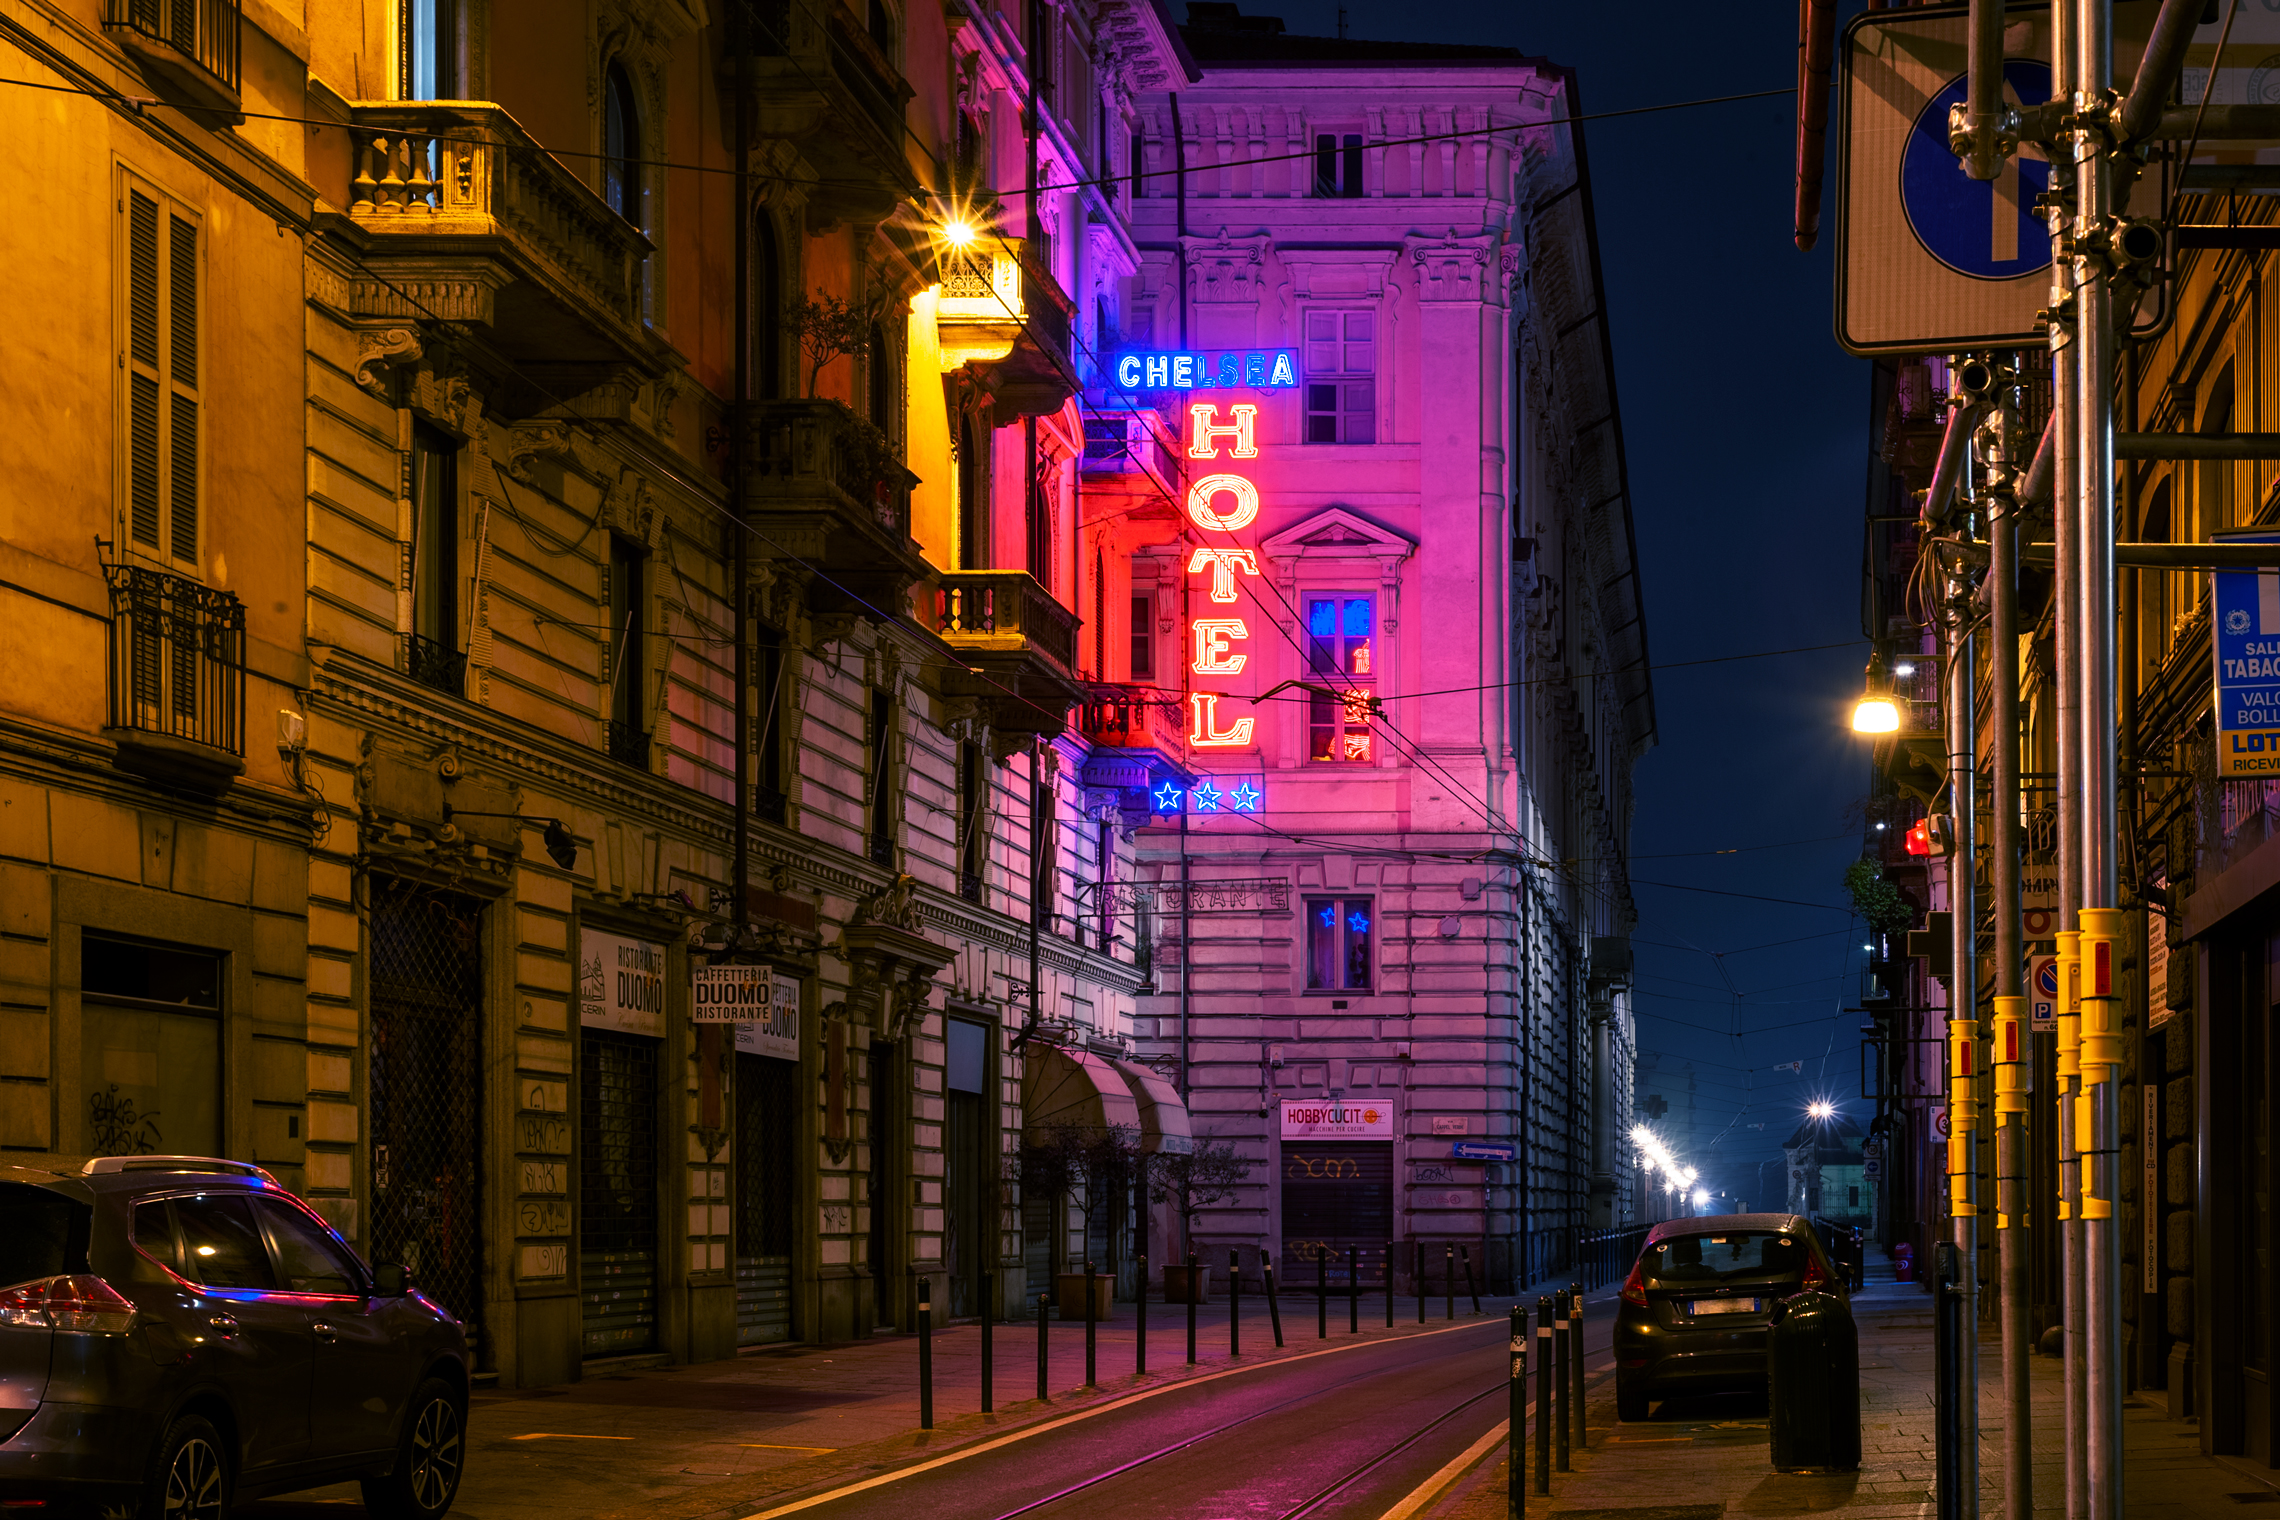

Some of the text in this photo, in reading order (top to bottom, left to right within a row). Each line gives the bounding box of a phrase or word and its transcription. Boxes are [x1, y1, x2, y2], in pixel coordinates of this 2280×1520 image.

[1118, 353, 1295, 388] CHELSEA
[1187, 403, 1260, 747] HOTEL
[2245, 641, 2280, 655] SAL
[1103, 884, 1286, 911] RISTORANTE
[618, 945, 662, 975] RISTORANTE
[696, 969, 769, 982] CAFFETTERIA
[618, 971, 662, 1014] DUOMO
[696, 983, 769, 1005] DUOMO
[696, 1006, 769, 1019] RISTORANTE
[2038, 1003, 2049, 1018] P
[1288, 1108, 1361, 1124] HOBBYCUCIT
